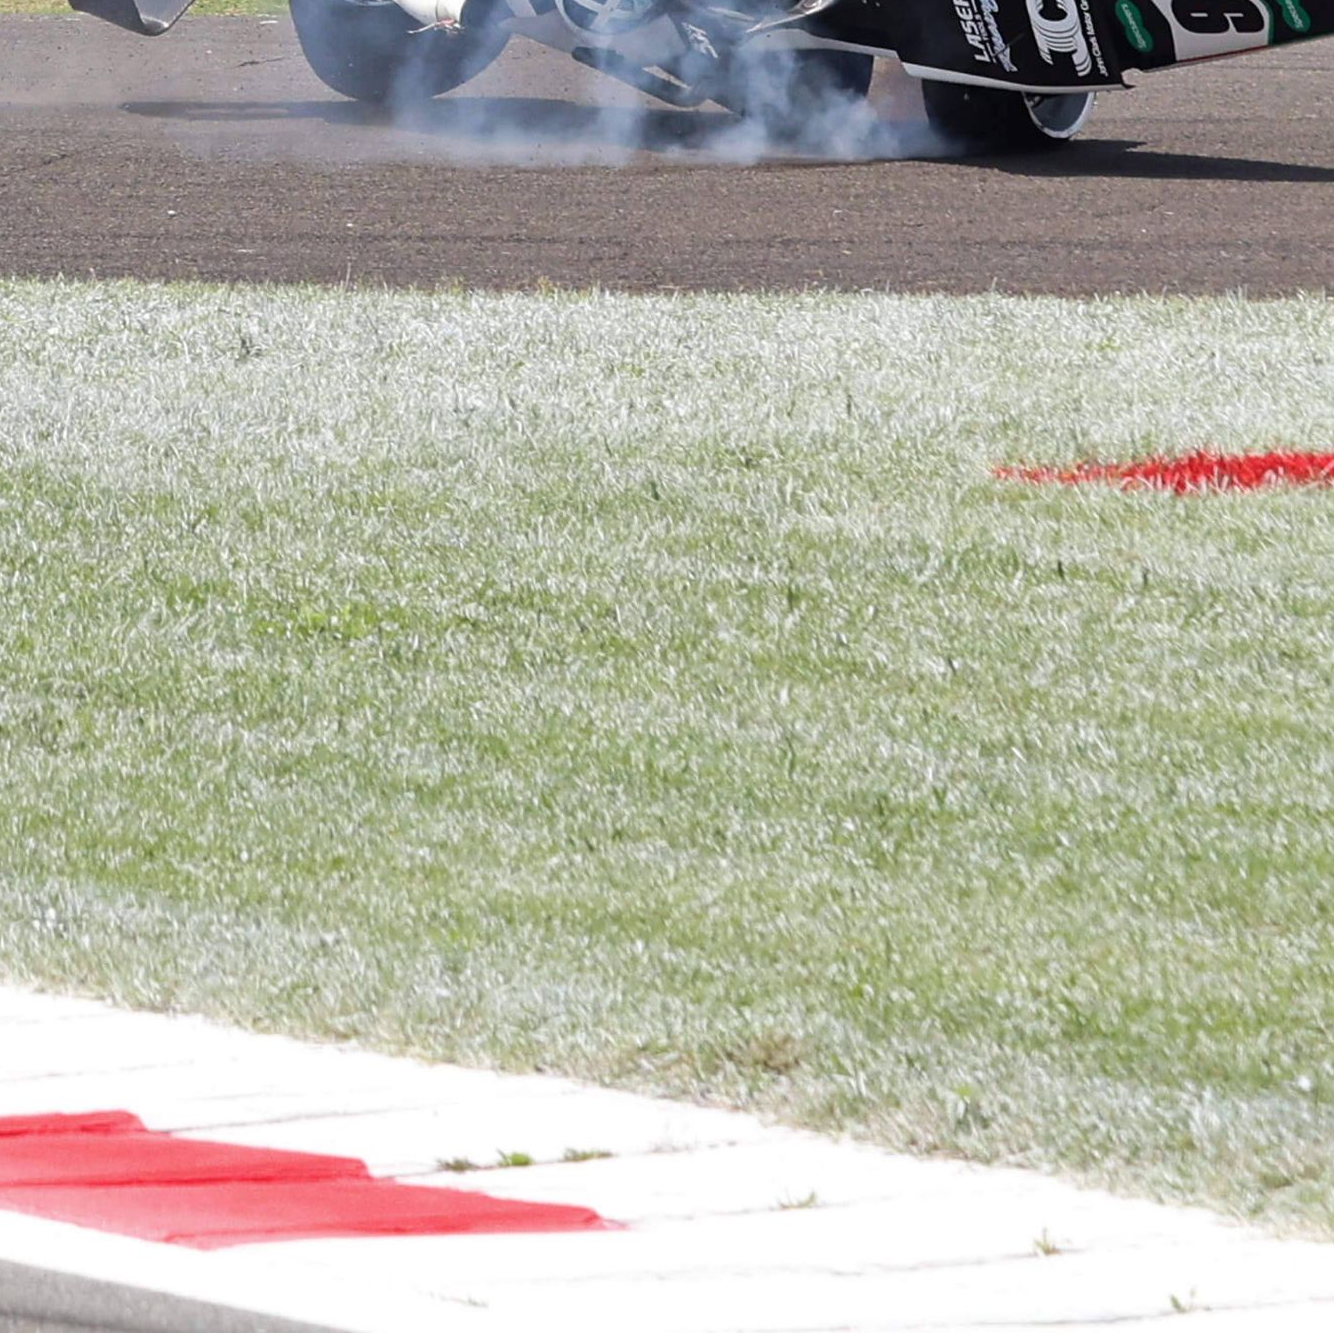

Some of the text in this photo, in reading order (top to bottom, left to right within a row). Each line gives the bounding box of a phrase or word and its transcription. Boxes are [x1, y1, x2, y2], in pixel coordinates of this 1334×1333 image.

[1083, 12, 1096, 35] Motor
[1088, 35, 1102, 57] Clark
[1094, 56, 1109, 77] John
